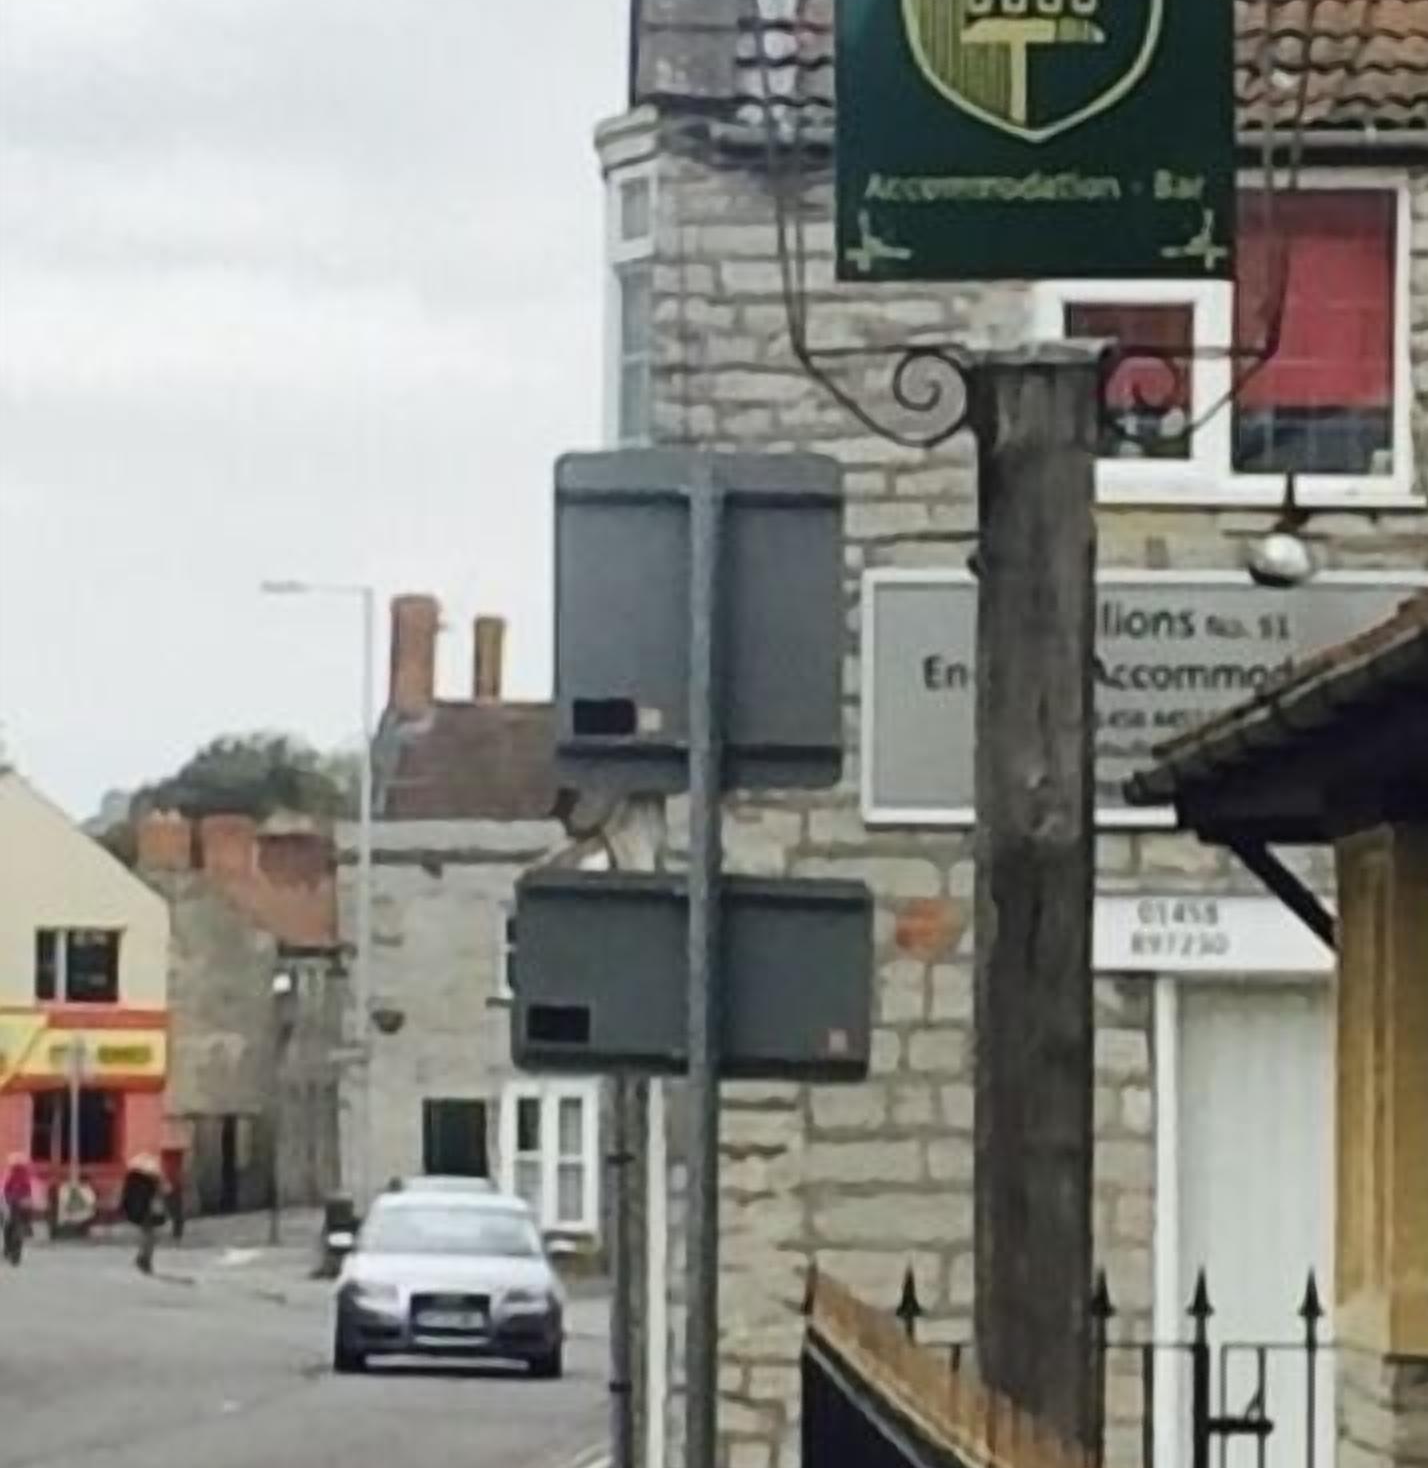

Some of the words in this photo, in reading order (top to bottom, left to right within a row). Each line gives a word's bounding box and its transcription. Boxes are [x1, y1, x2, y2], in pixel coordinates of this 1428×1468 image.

[864, 170, 1121, 202] Accommodation
[1153, 168, 1205, 201] Bar
[1102, 600, 1196, 639] lions
[1093, 654, 1295, 692] Accommod
